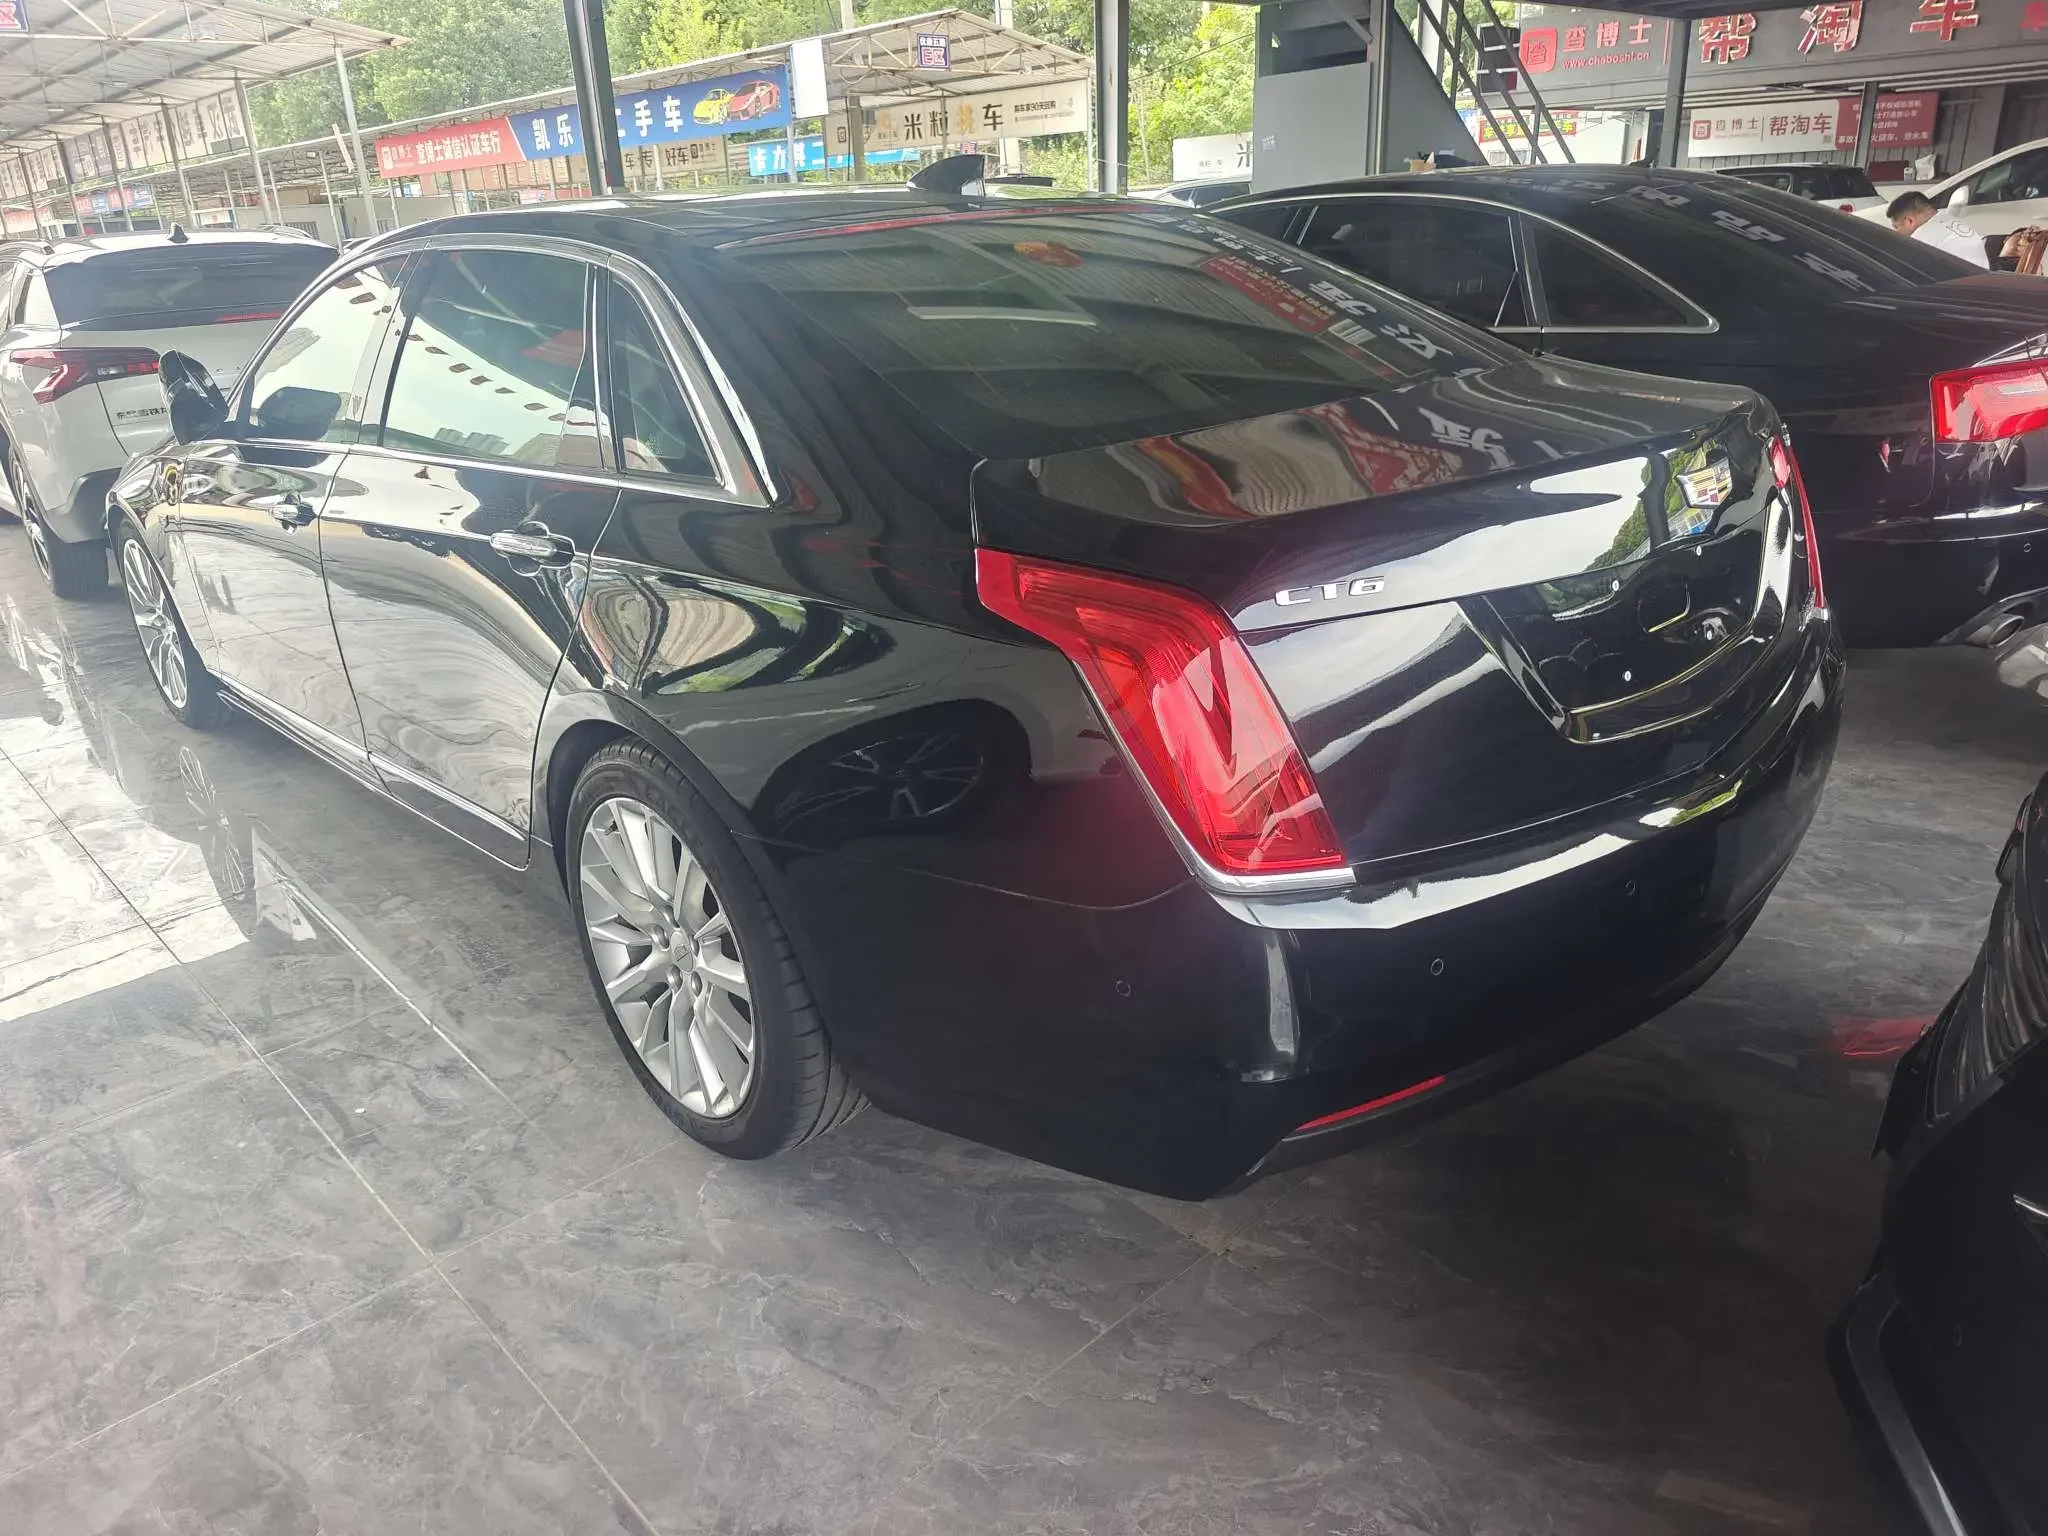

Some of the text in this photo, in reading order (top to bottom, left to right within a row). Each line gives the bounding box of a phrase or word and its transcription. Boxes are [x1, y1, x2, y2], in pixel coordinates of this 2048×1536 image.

[1562, 16, 1652, 53] 查博士
[532, 113, 574, 152] 凯乐
[1769, 112, 1833, 137] 帮淘车
[1275, 576, 1385, 606] CT6
